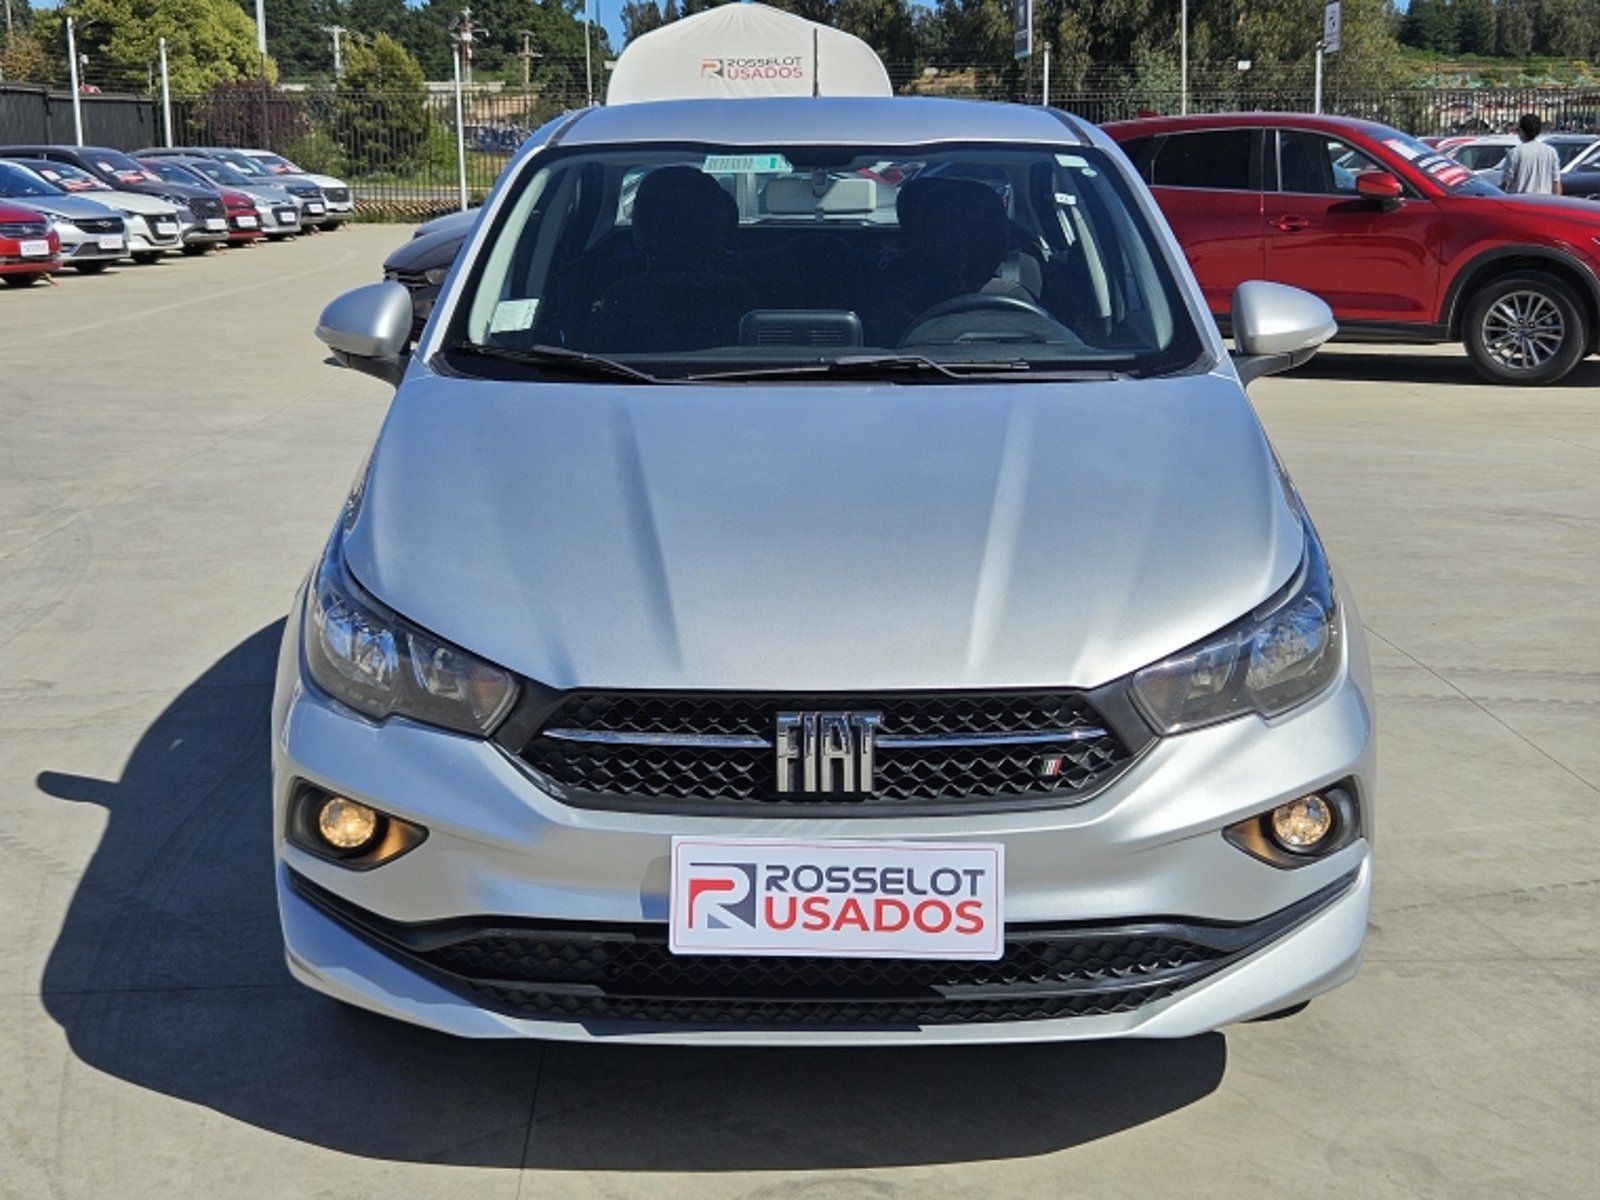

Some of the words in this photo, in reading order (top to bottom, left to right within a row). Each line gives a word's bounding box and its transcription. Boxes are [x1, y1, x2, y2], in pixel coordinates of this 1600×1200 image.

[726, 67, 803, 80] USADOS
[777, 711, 883, 793] FIAT
[765, 864, 986, 897] ROSSELOT
[764, 896, 985, 935] USADOS
